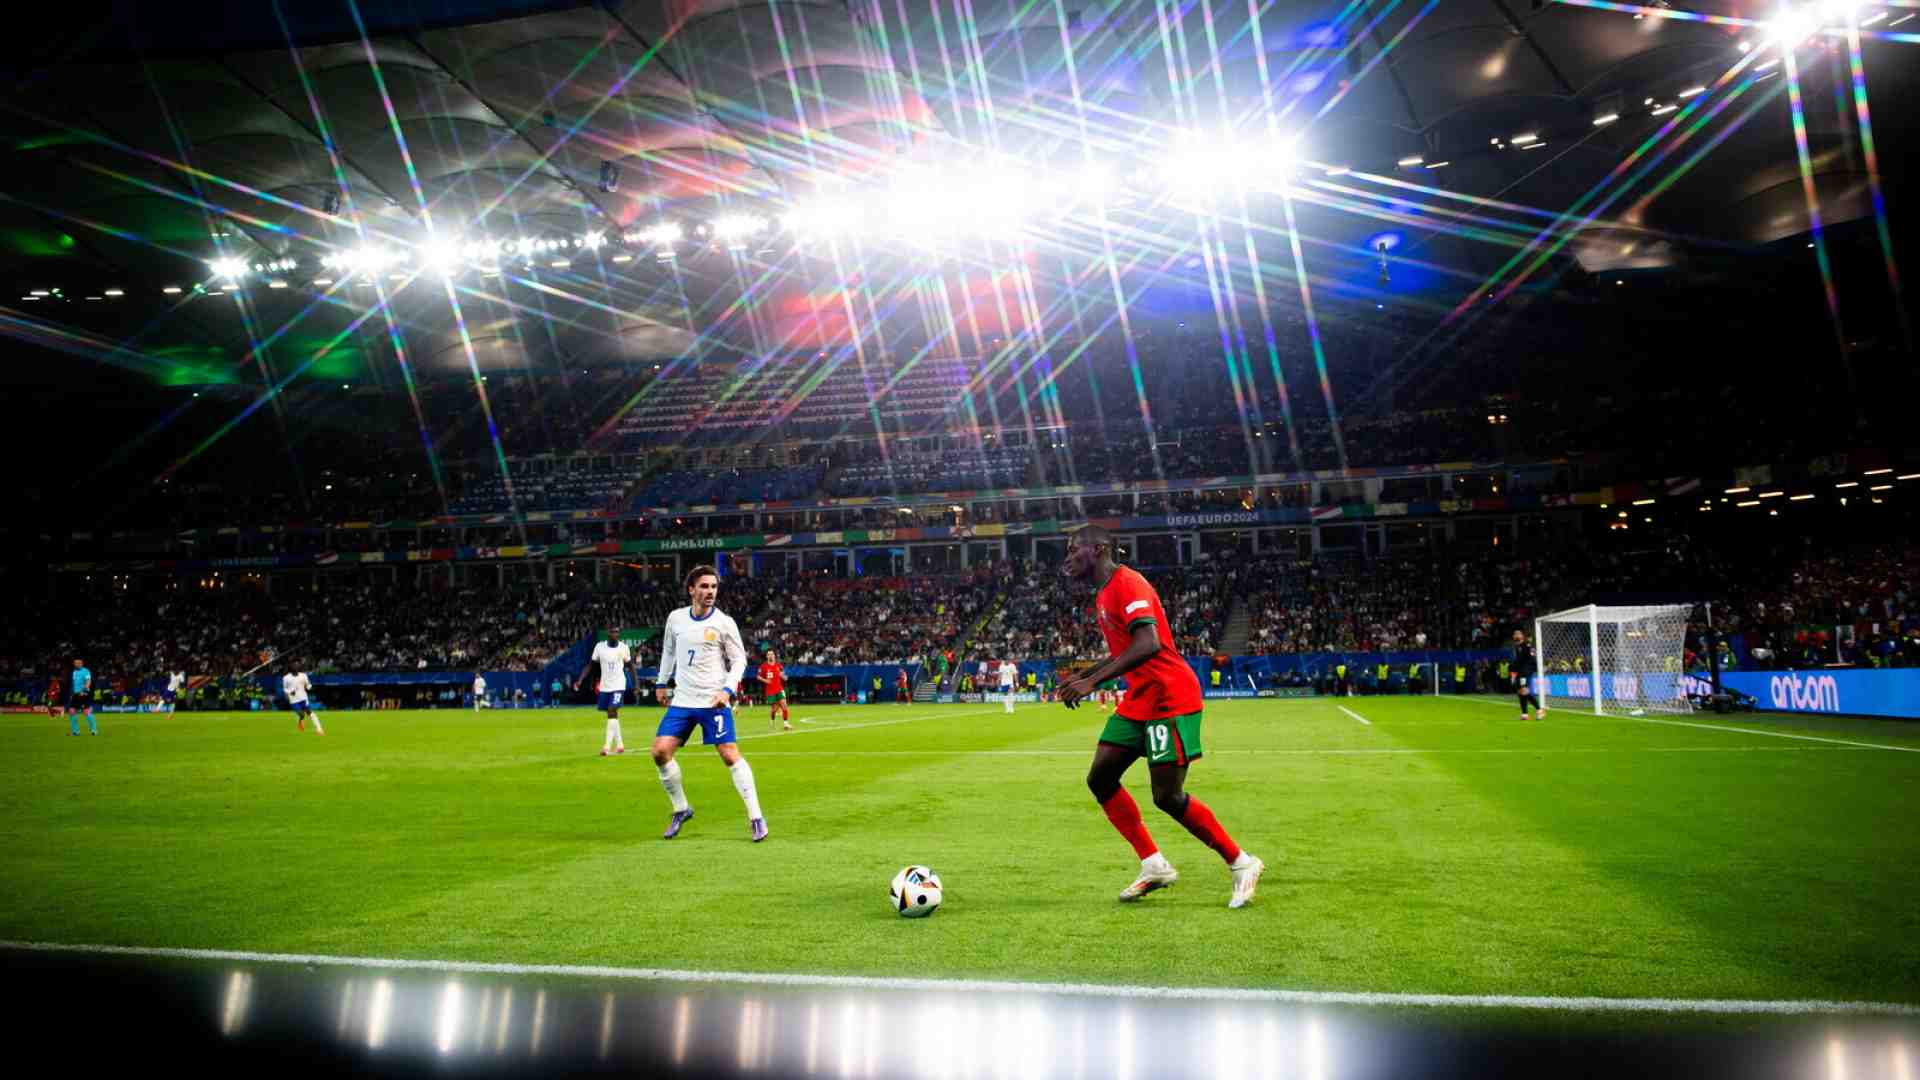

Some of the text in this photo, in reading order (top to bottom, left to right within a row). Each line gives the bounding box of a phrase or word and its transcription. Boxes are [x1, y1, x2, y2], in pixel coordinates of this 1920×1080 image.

[688, 649, 695, 666] 7
[1771, 672, 1839, 712] antom
[714, 715, 723, 733] 7
[1148, 725, 1168, 750] 19
